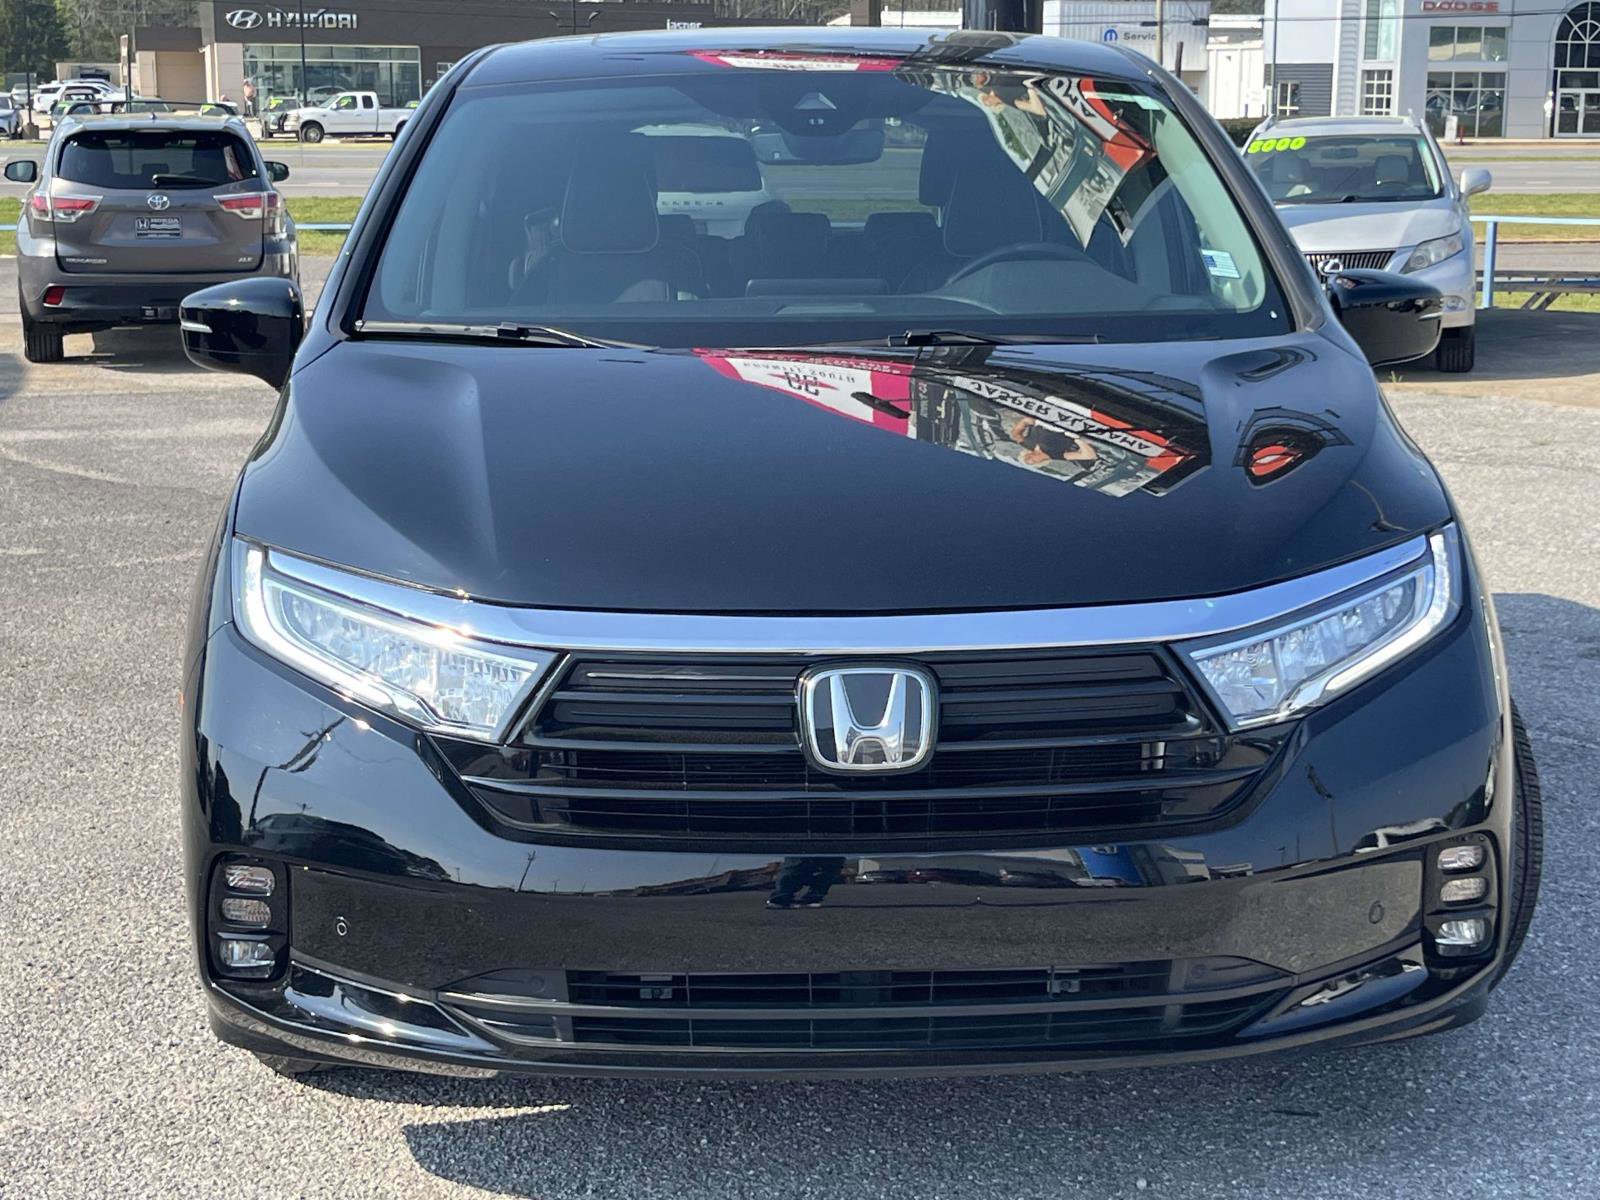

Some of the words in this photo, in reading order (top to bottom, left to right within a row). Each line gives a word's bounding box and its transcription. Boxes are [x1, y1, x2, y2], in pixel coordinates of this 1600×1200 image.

[1422, 1, 1499, 12] DODGE
[267, 12, 358, 29] HYUNDAI
[1123, 32, 1157, 41] Servic
